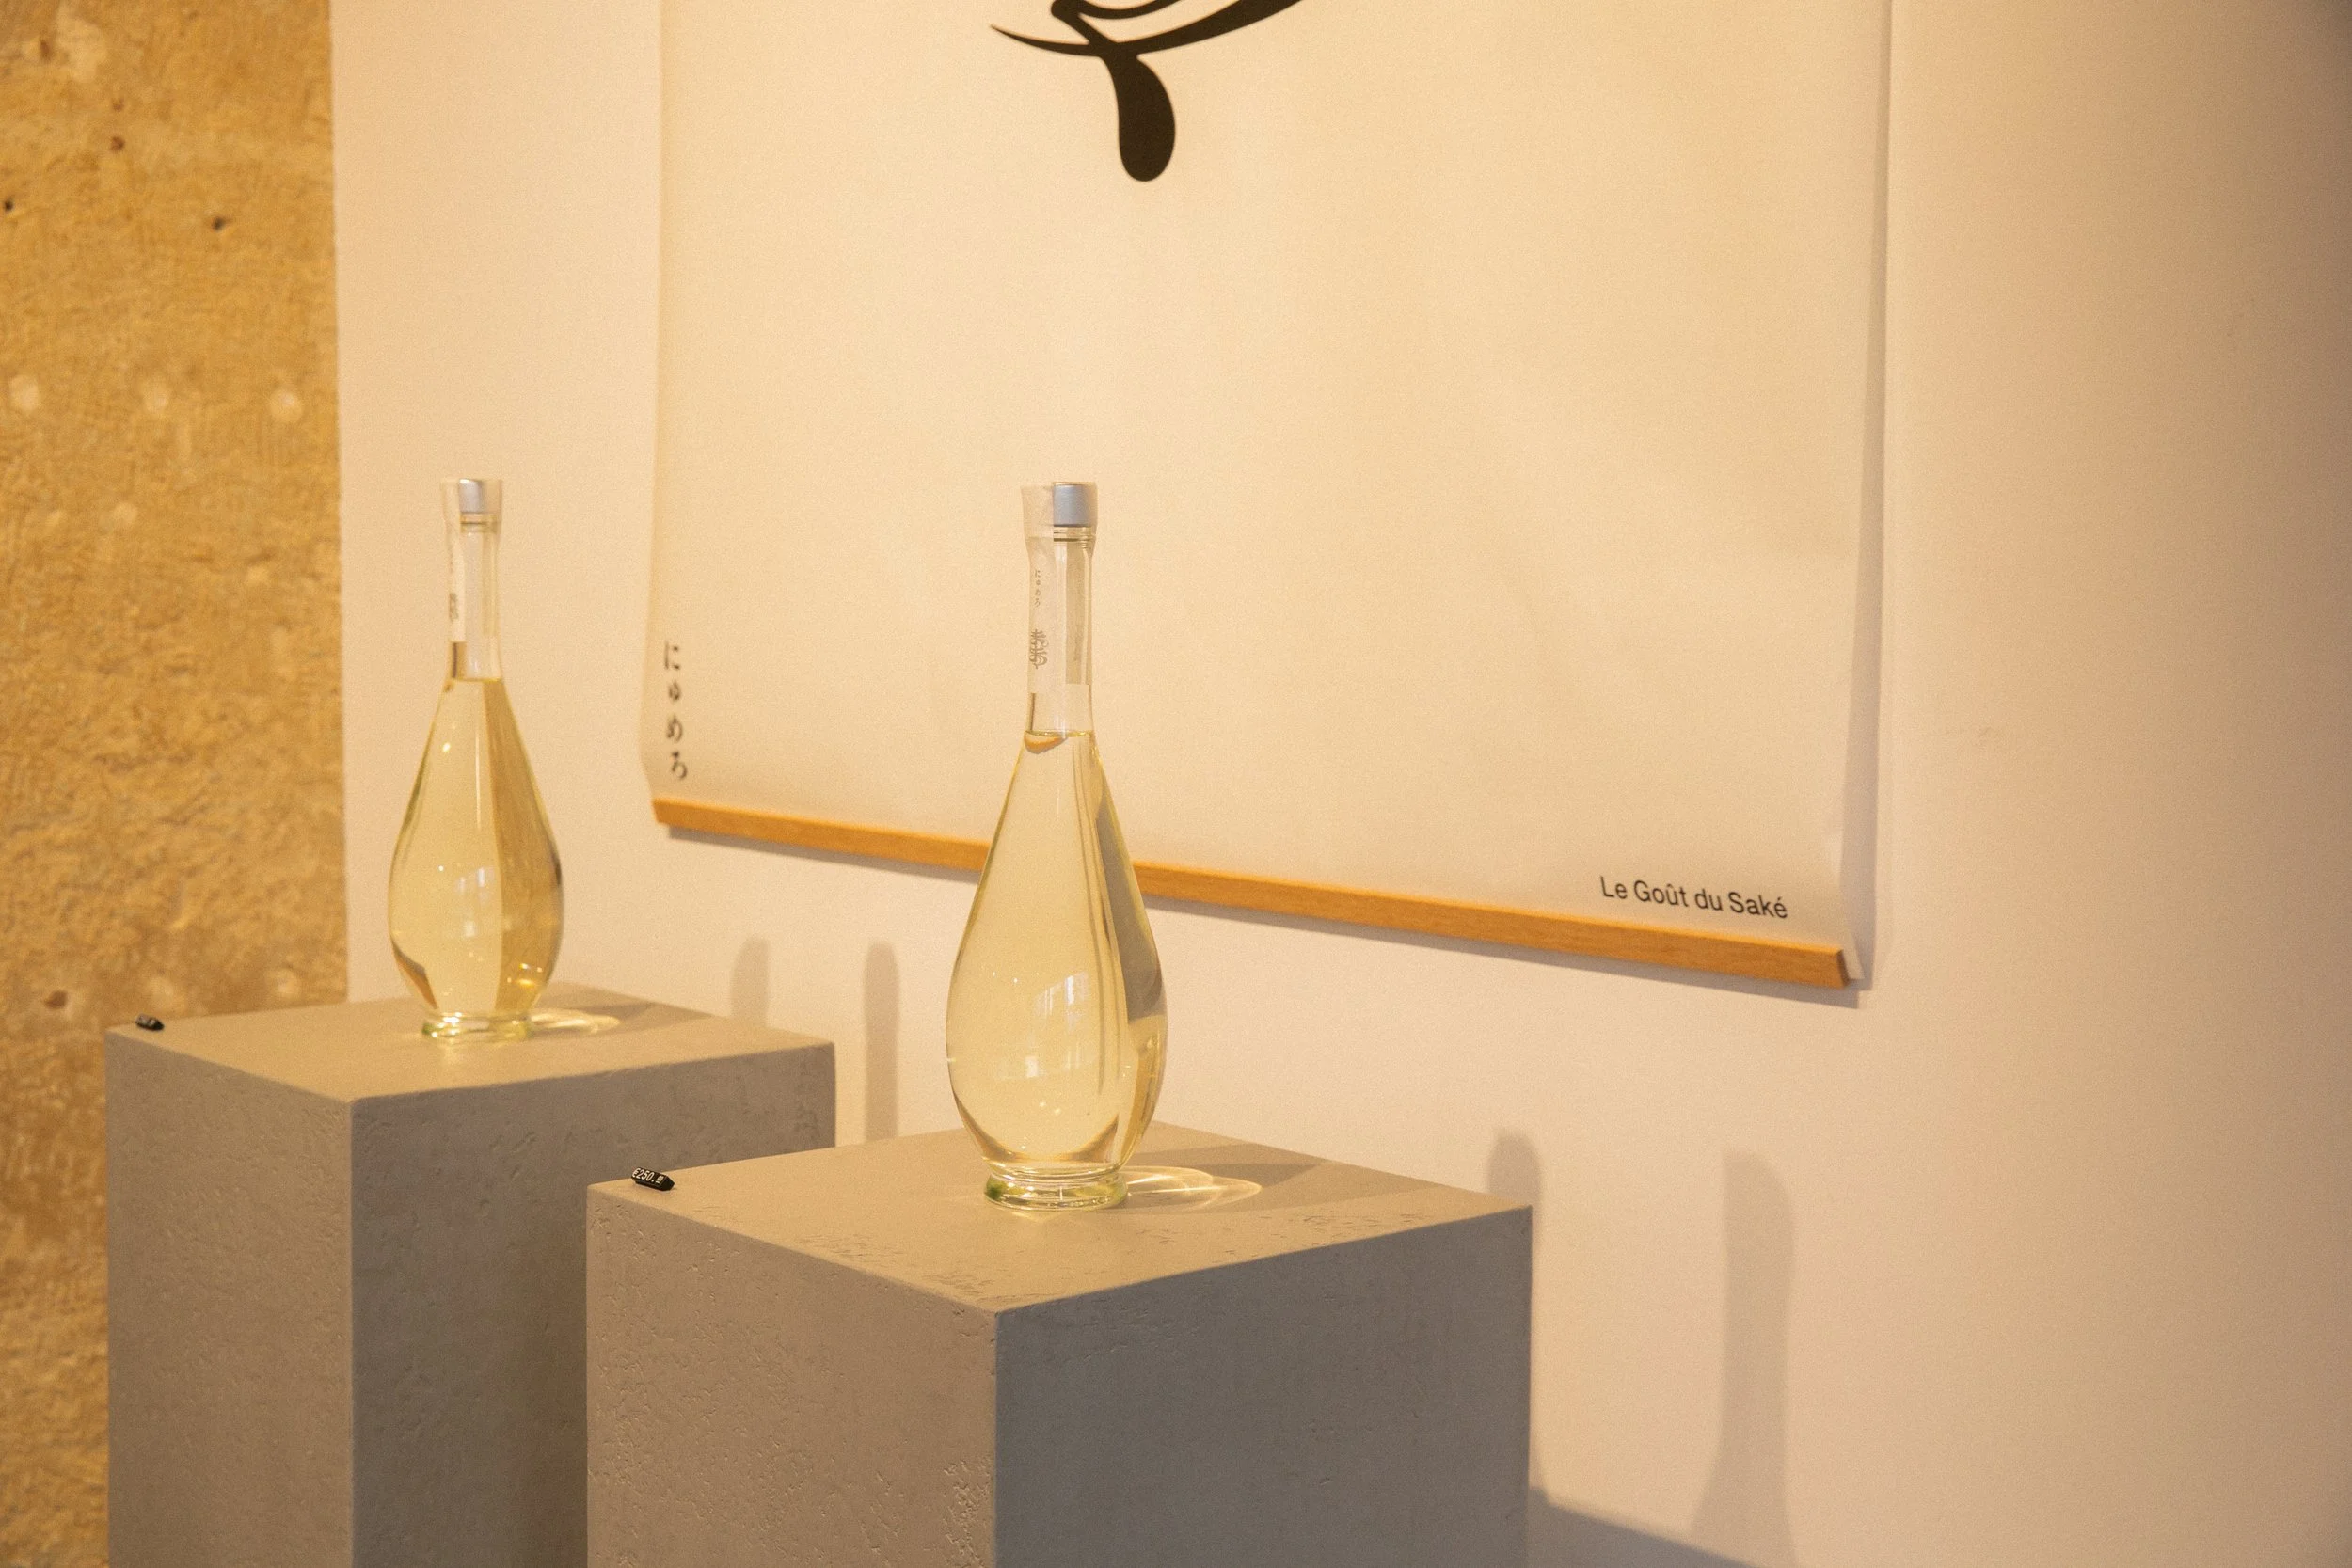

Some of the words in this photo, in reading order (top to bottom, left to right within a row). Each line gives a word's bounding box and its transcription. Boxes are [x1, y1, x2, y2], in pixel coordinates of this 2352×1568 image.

[1599, 876, 1628, 900] Le
[1633, 879, 1689, 908] Goût
[1694, 888, 1724, 911] du
[1727, 891, 1788, 920] Saké
